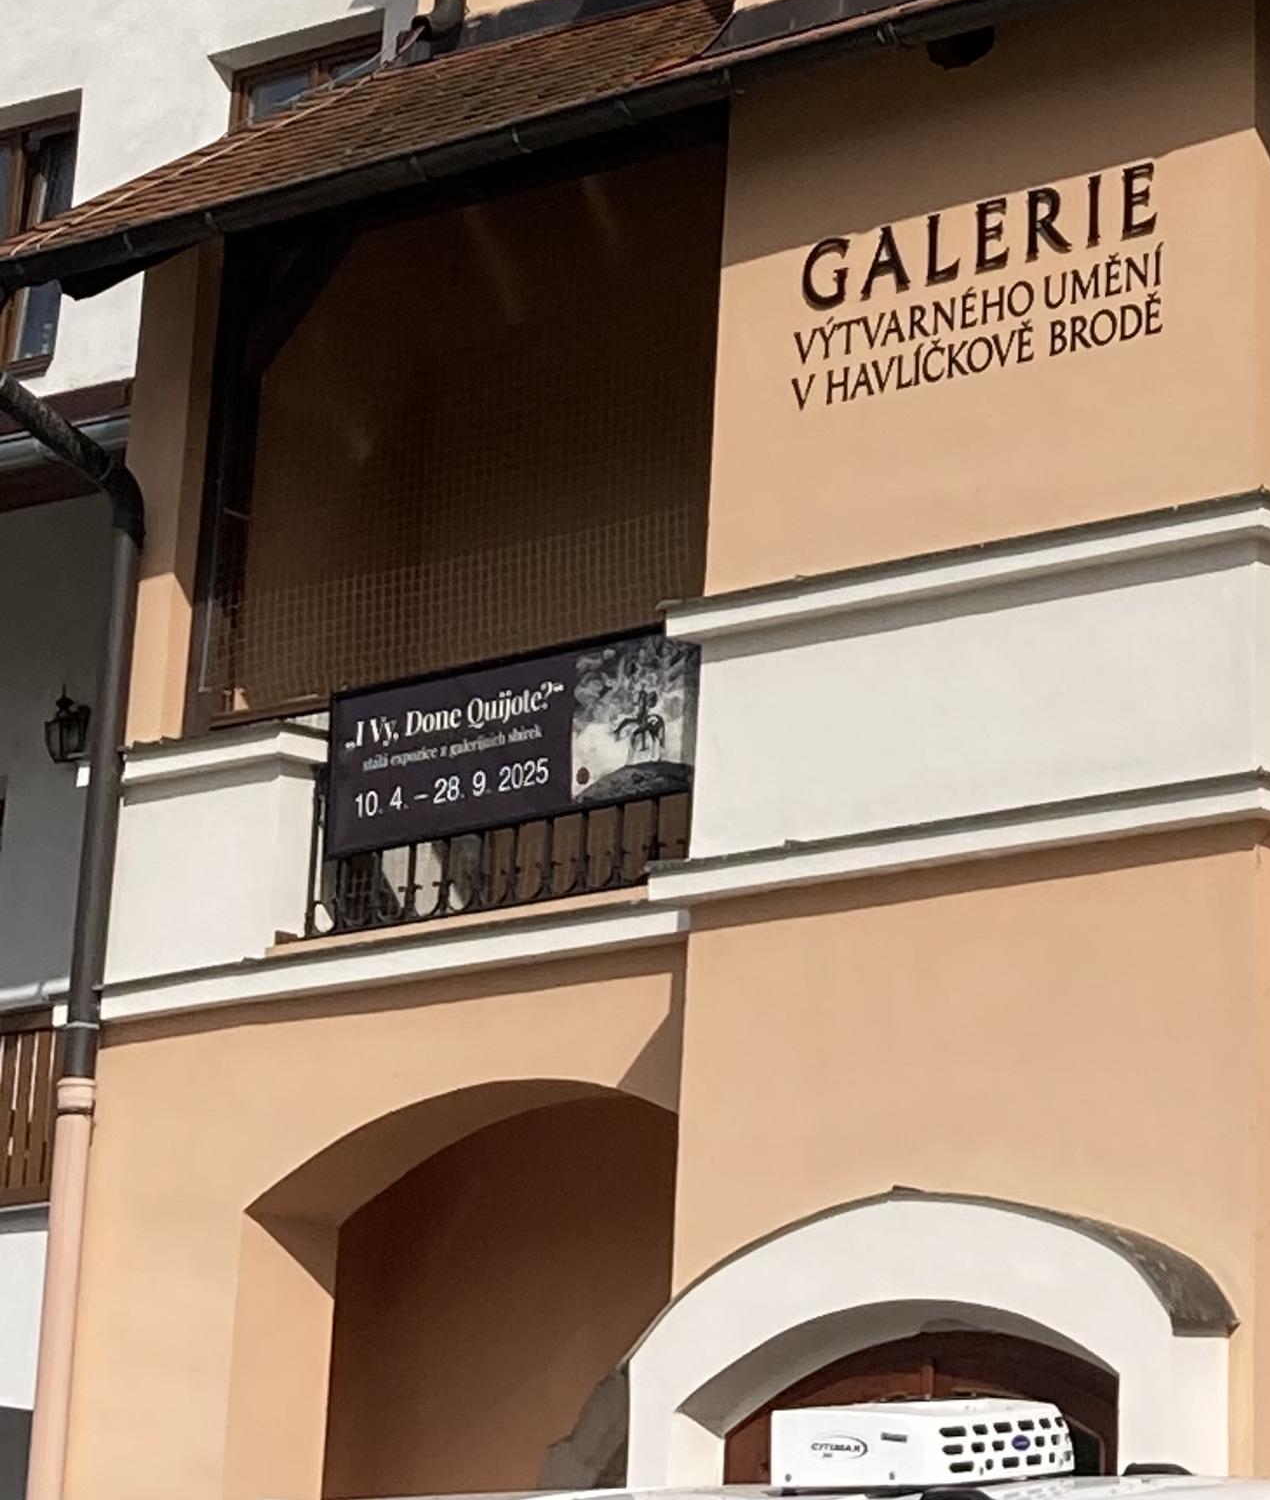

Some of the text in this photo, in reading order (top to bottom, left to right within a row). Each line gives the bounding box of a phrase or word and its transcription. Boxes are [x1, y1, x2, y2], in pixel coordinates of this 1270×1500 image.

[801, 161, 1158, 311] GALERIE
[791, 290, 1163, 412] V HAVLÍČKOVĚ BRODĚ
[793, 241, 1164, 365] VÝTVARNÉHO UMĚNÍ
[405, 707, 461, 737] Done
[354, 790, 383, 819] 10.
[389, 785, 410, 811] 4.
[433, 776, 466, 805] 28.
[472, 770, 492, 796] 9.
[499, 758, 549, 792] 2025
